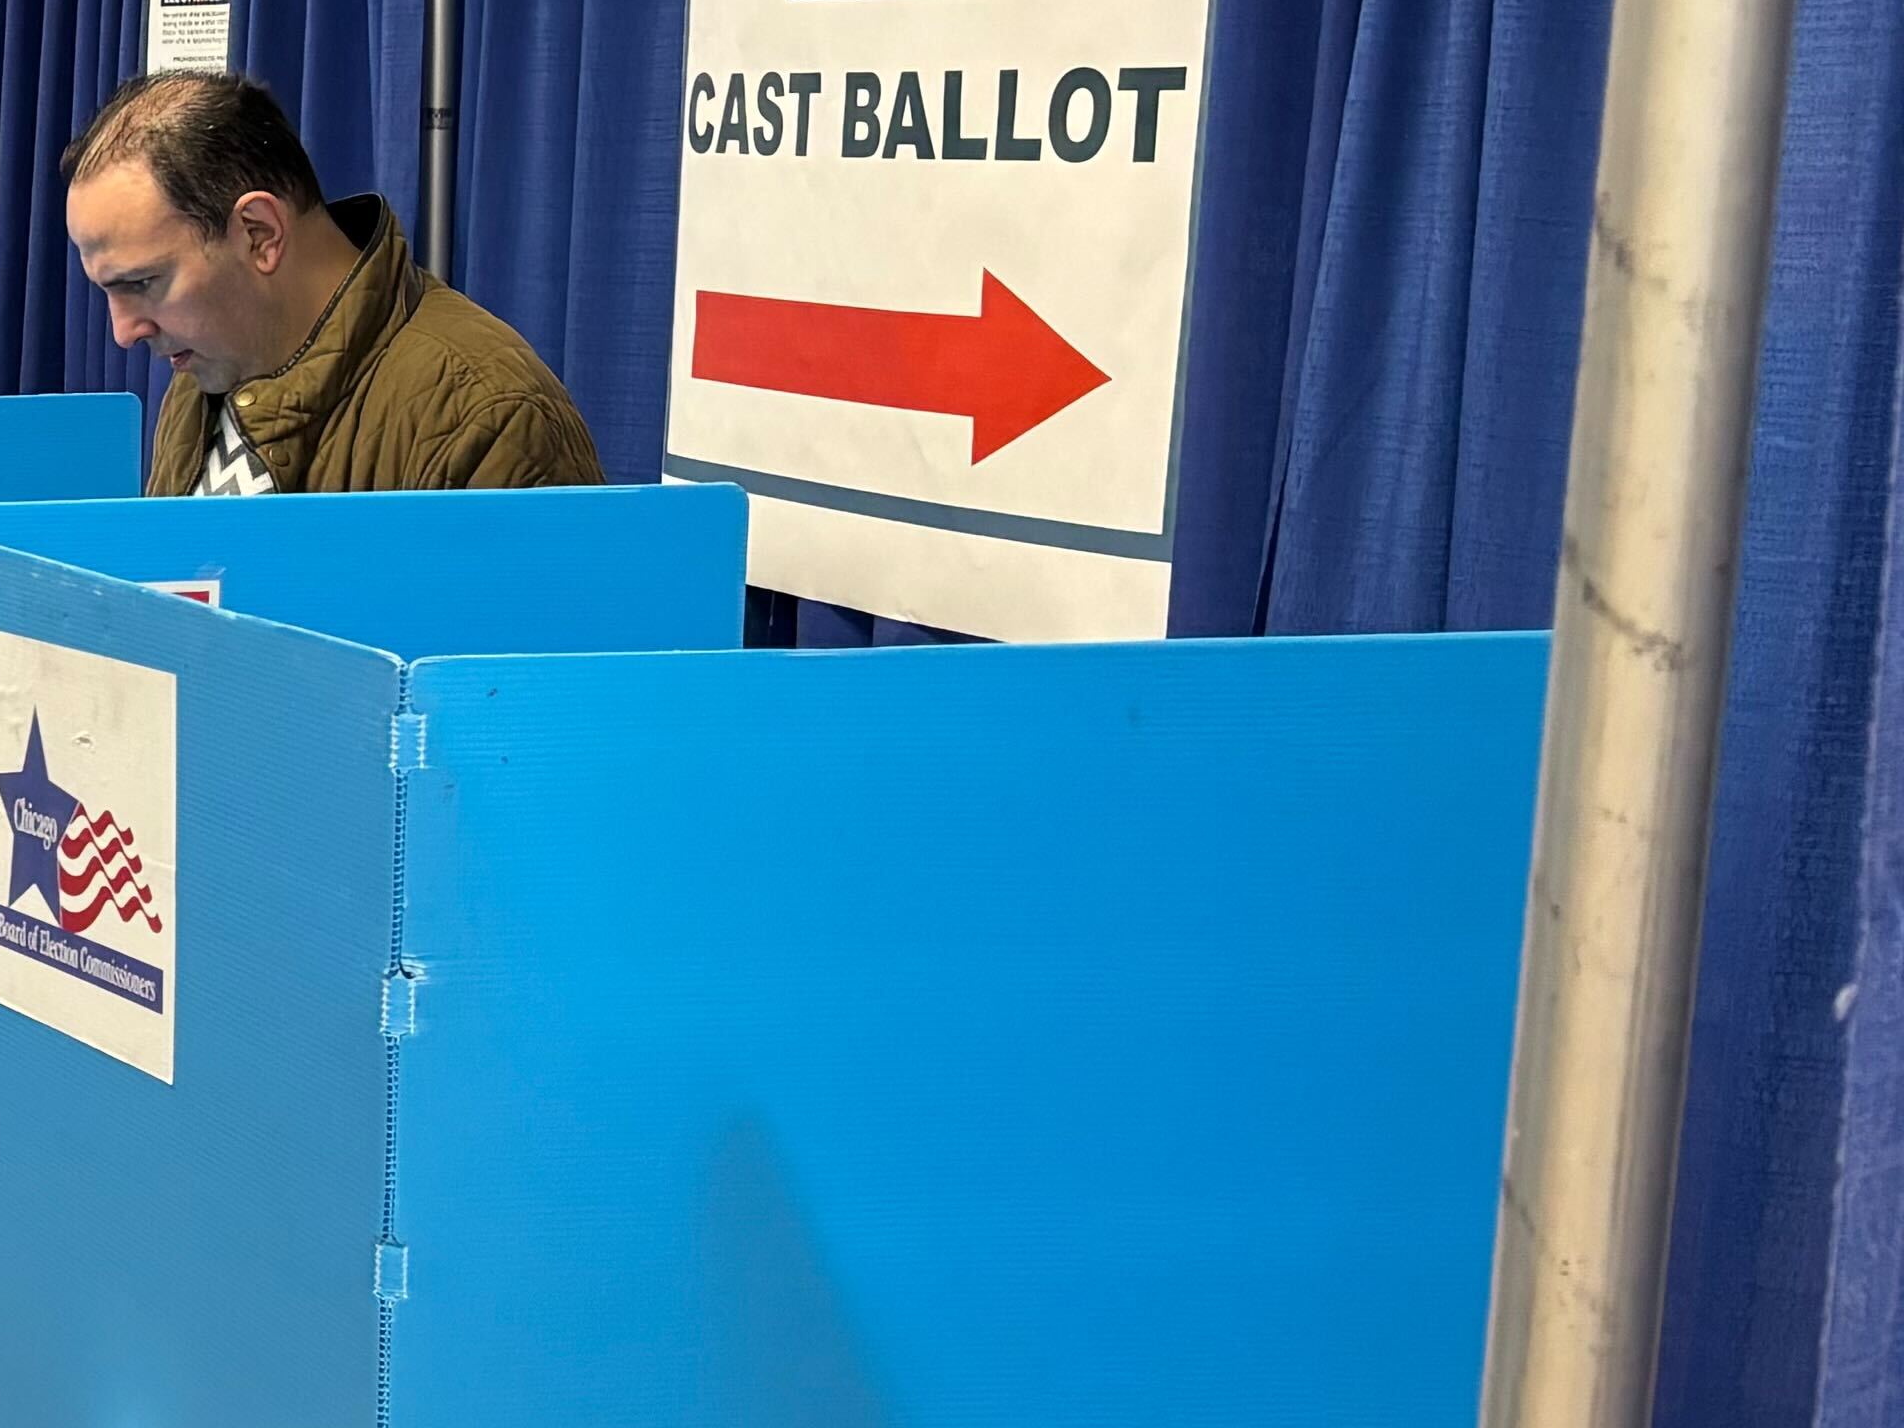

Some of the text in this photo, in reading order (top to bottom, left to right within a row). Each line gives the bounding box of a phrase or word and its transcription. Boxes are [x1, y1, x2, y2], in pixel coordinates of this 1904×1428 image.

[688, 66, 1188, 164] CAST BALLOT
[14, 797, 58, 851] Chicago
[28, 924, 39, 951] of
[39, 929, 79, 969] Election
[80, 946, 157, 1002] Commissioners
